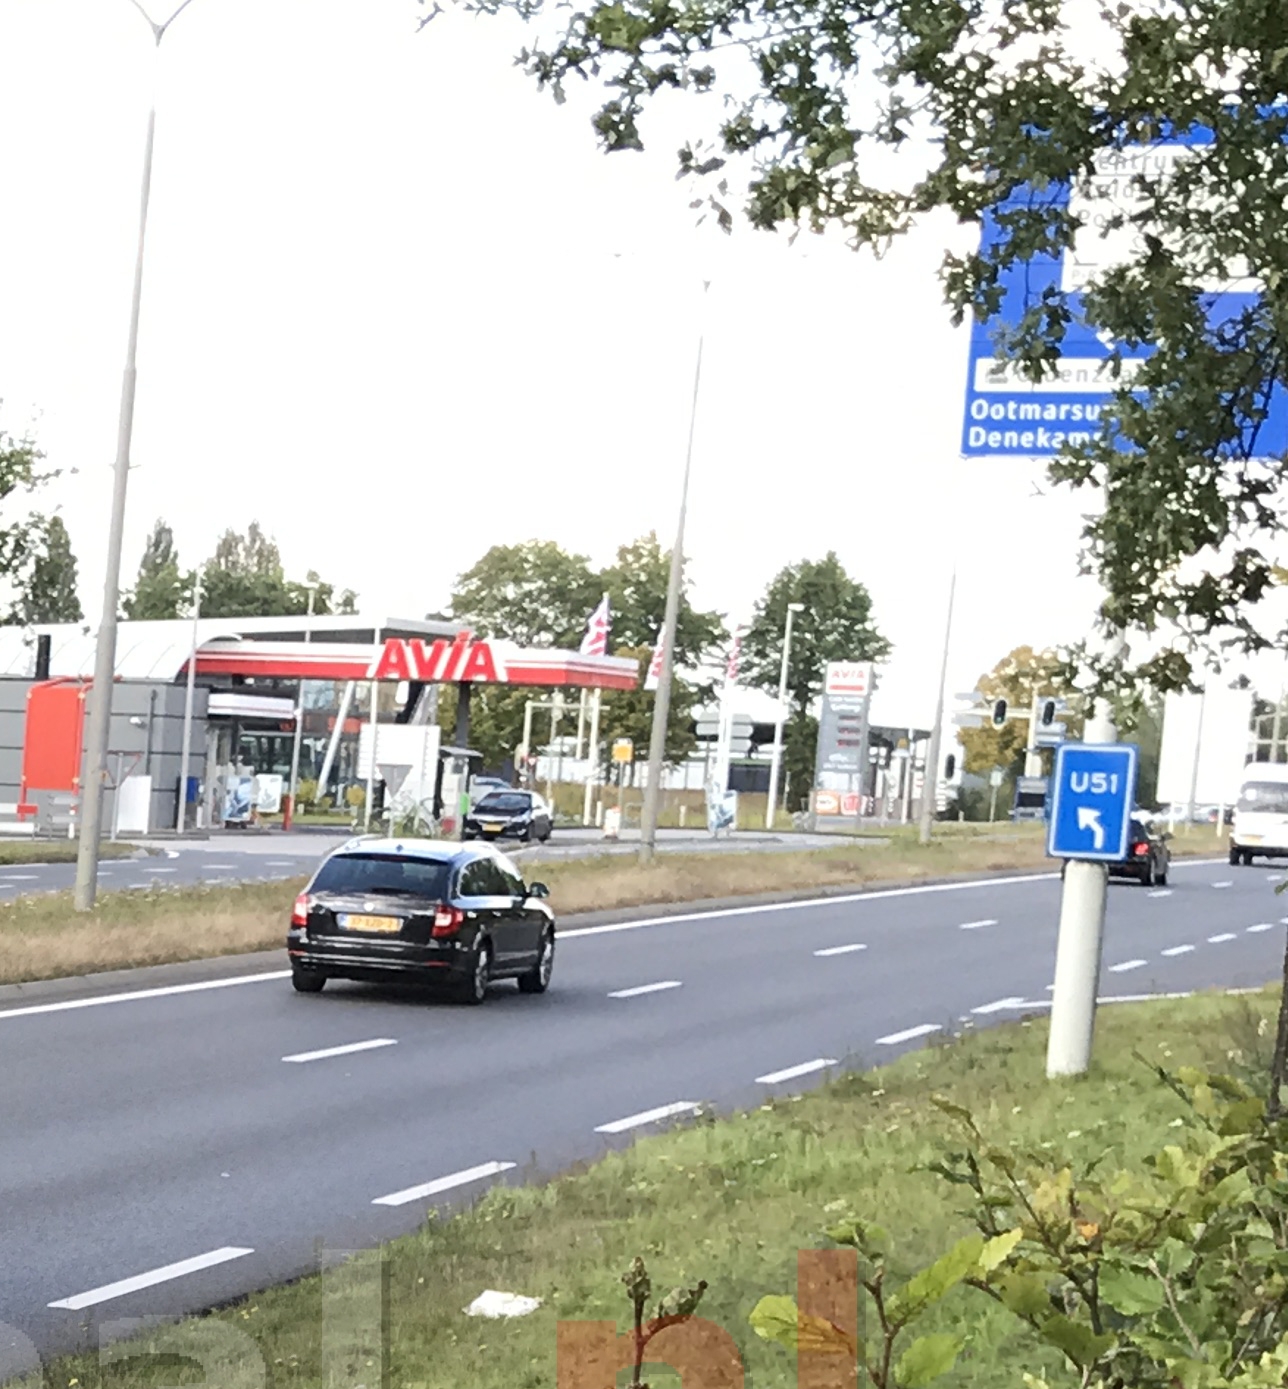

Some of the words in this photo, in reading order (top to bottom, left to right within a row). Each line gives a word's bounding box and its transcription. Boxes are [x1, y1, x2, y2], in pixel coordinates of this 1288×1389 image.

[970, 398, 1114, 421] Ootmarsu
[968, 425, 1108, 449] Denekam
[1070, 771, 1118, 795] U51
